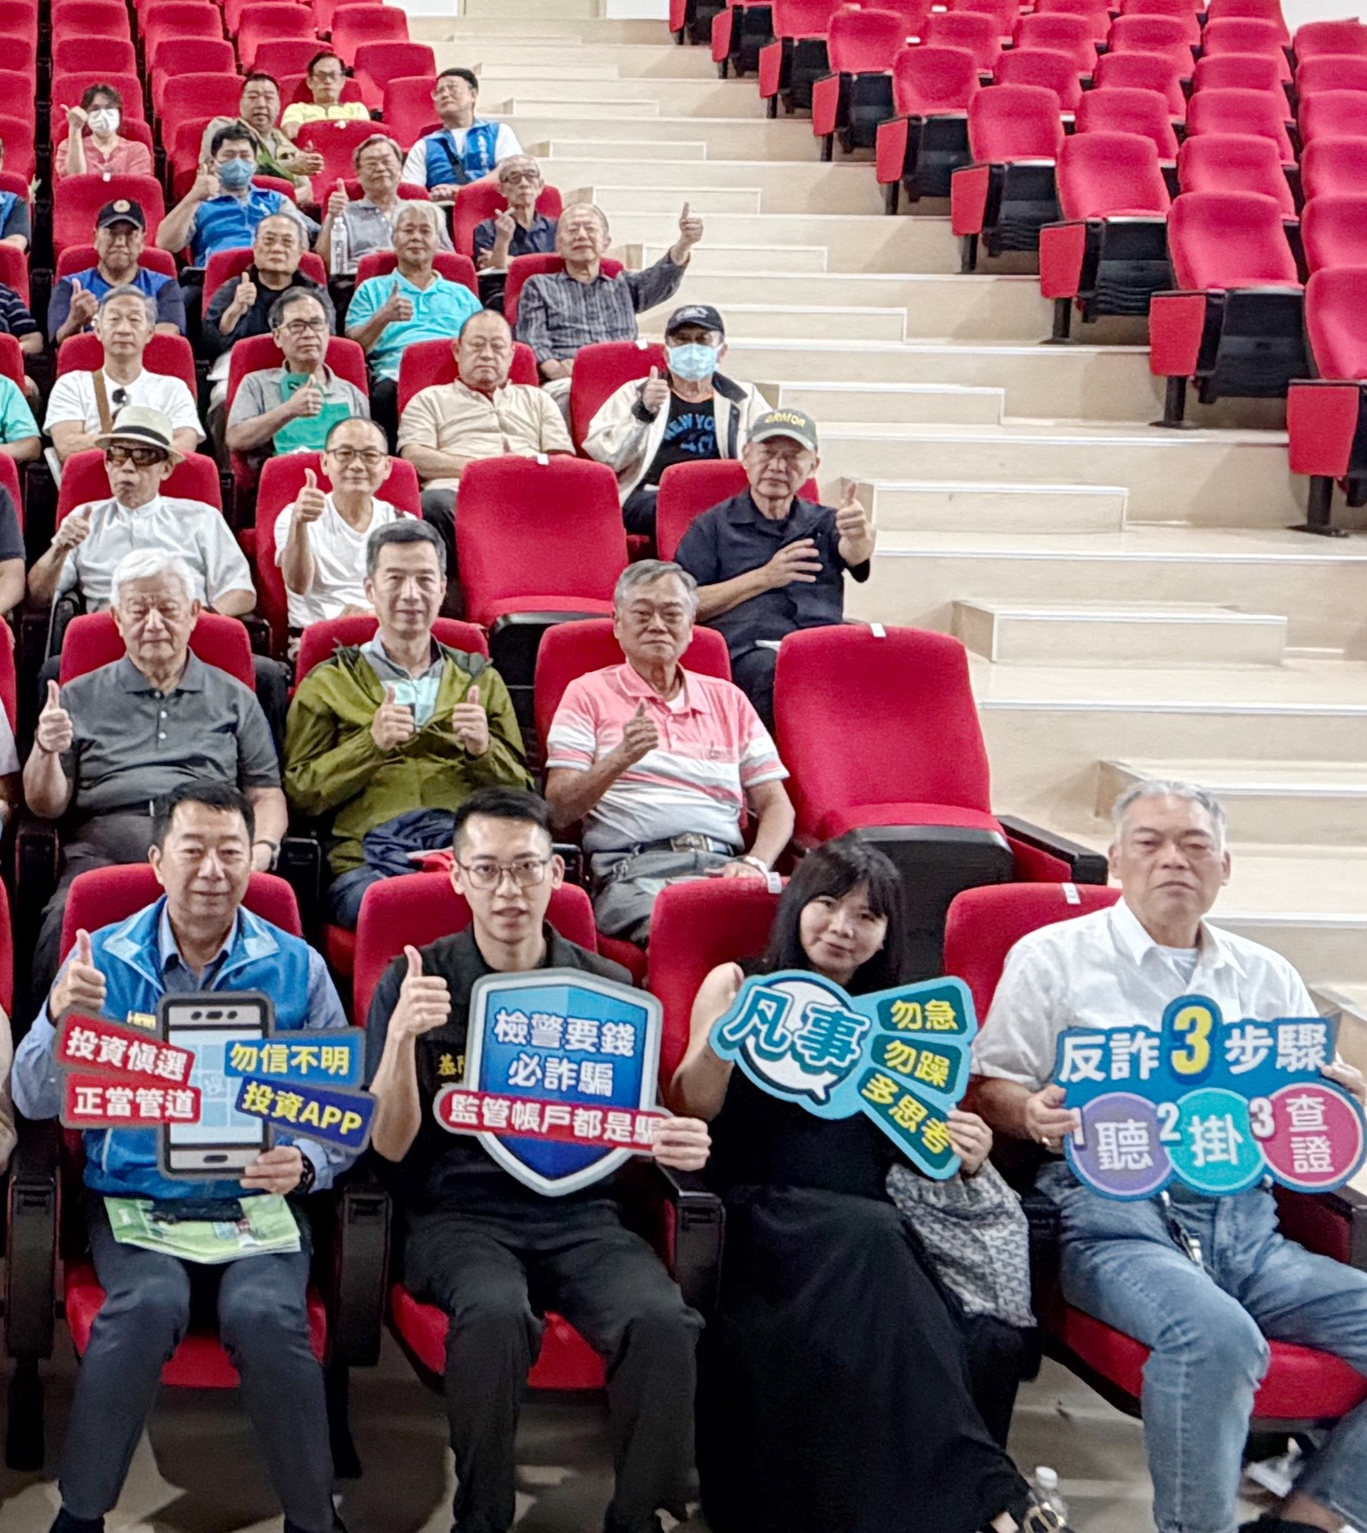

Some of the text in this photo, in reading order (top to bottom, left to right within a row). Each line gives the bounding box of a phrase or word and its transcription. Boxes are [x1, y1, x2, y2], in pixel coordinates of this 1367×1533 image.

[493, 1009, 636, 1057] 檢警要錢
[722, 985, 872, 1068] 凡事
[890, 1000, 958, 1030] 勿急
[229, 1042, 350, 1076] 勿信不明
[508, 1053, 614, 1097] 必詐騙
[884, 1040, 950, 1087] 勿躁
[73, 1086, 195, 1118] 正當管道
[243, 1080, 364, 1135] 投資APP
[861, 1073, 952, 1154] 多思考
[1249, 1097, 1275, 1138] 3
[1094, 1119, 1153, 1171] 聽
[1157, 1102, 1244, 1167] 2 掛
